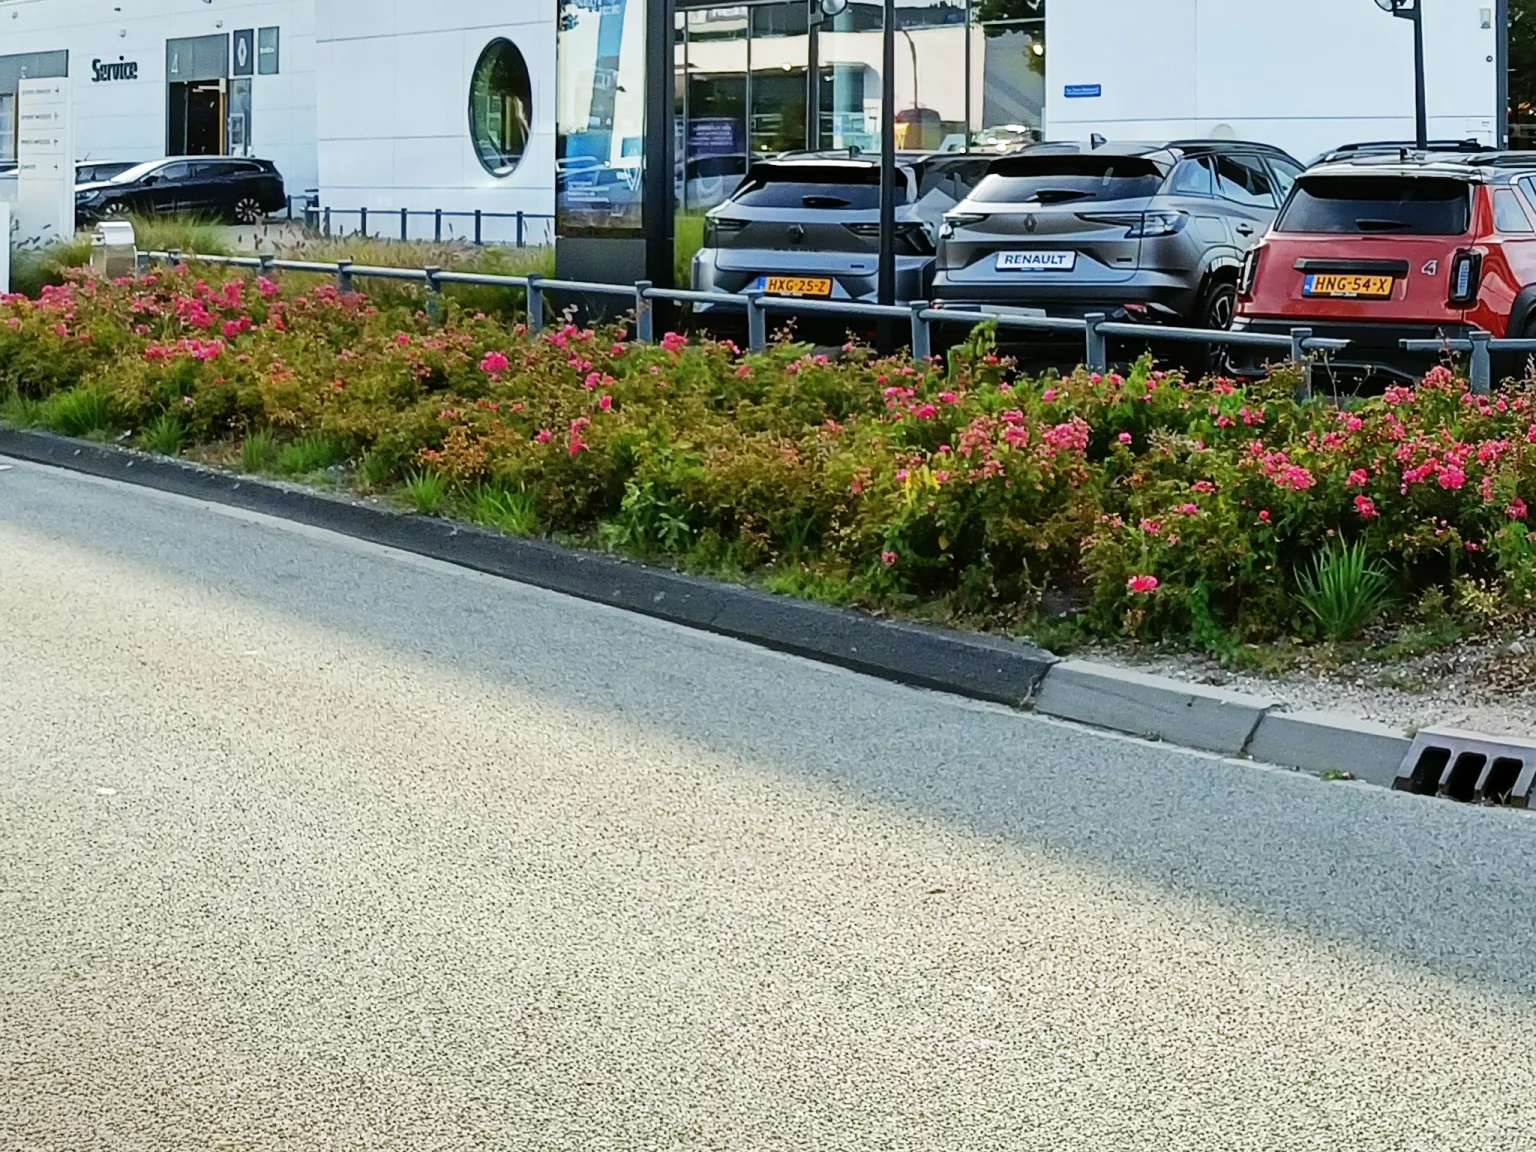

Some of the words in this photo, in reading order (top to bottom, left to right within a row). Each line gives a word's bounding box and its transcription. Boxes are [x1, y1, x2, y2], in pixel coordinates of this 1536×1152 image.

[92, 55, 138, 83] Service
[171, 53, 179, 75] 4
[1004, 254, 1067, 265] RENAULT
[1421, 260, 1438, 275] 4
[768, 278, 827, 293] HXG-25-Z
[1314, 276, 1388, 293] HNG-54-X
